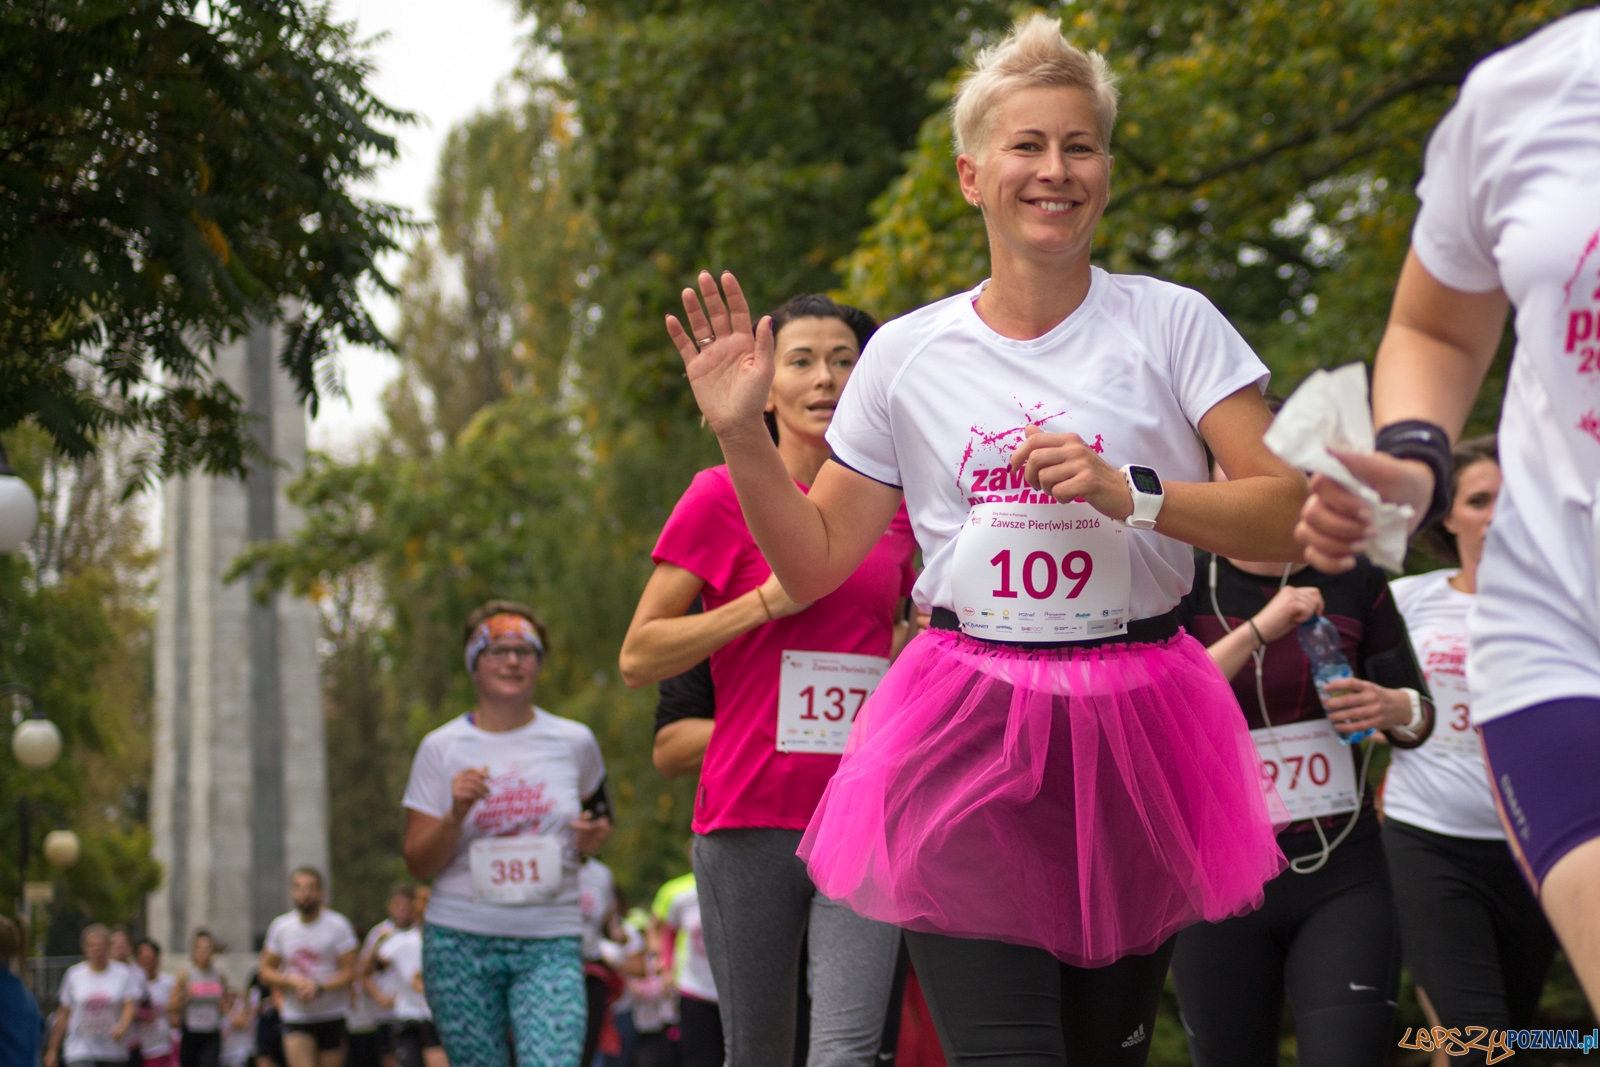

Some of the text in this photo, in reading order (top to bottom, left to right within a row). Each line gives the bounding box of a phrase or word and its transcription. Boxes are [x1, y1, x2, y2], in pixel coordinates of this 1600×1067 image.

[971, 465, 1031, 492] zaw
[991, 517, 1026, 529] Zawsze
[1028, 519, 1073, 531] Pier(w)si
[1075, 518, 1100, 529] 2016
[990, 549, 1094, 600] 109
[799, 686, 868, 722] 137
[1450, 703, 1472, 732] 3
[1262, 752, 1331, 794] 970
[490, 858, 541, 886] 381
